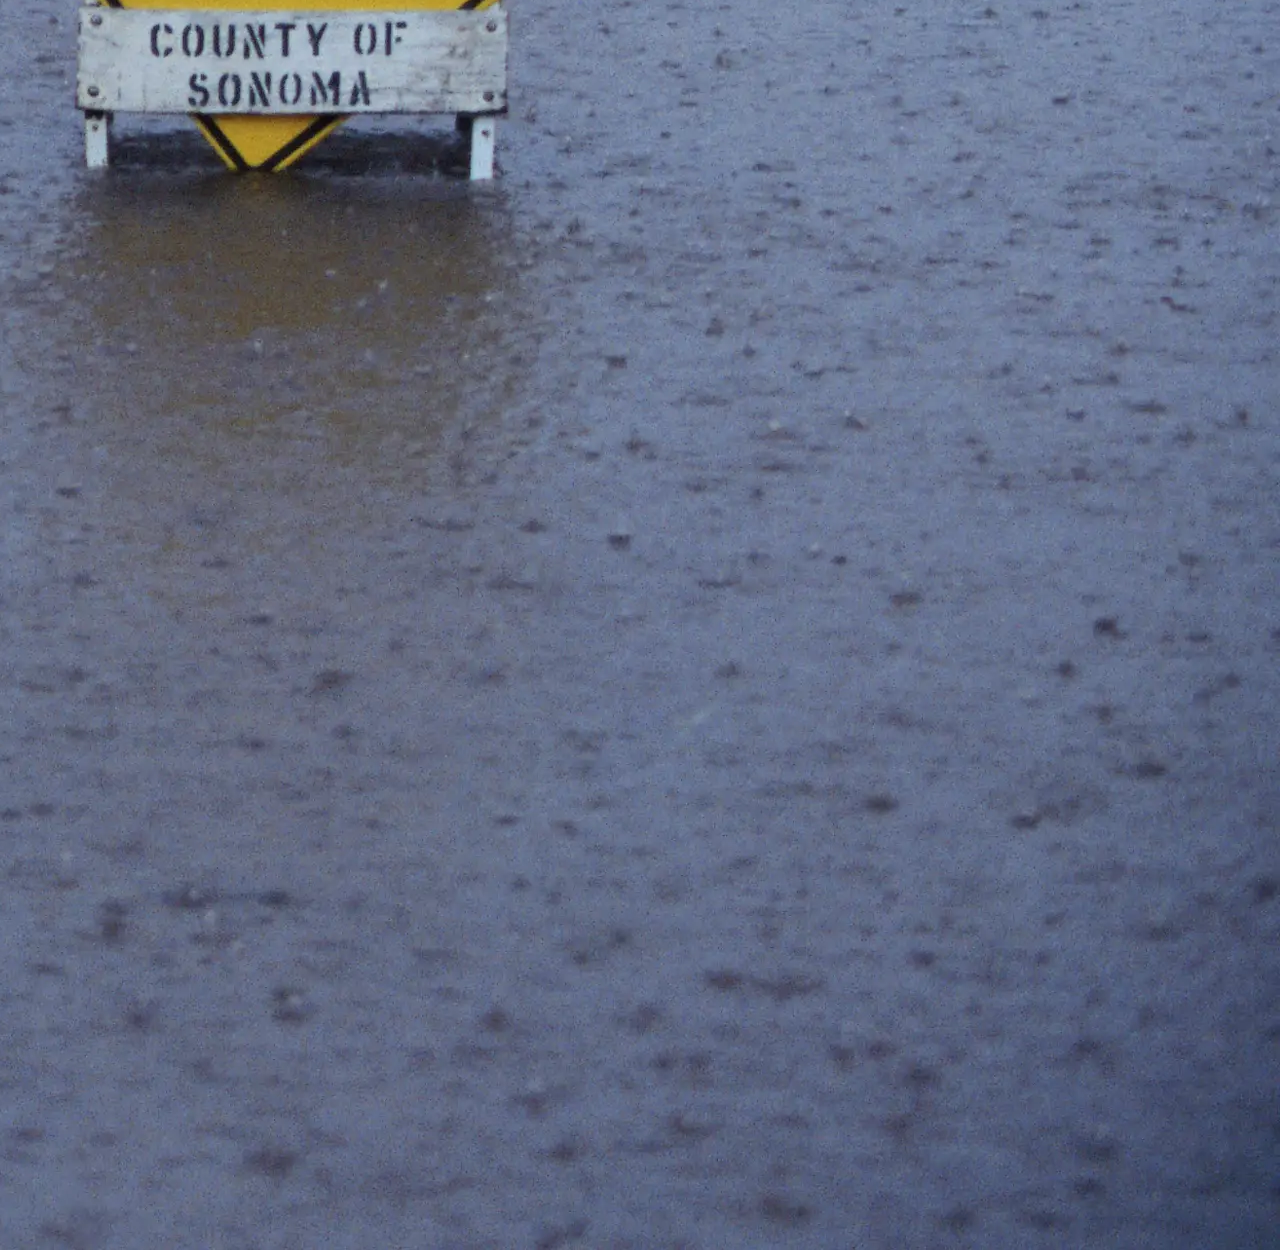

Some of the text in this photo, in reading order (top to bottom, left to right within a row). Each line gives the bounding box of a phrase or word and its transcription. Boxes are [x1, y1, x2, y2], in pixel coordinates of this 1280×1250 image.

[150, 21, 409, 58] COUNTY OF
[187, 71, 371, 107] SONOMA
